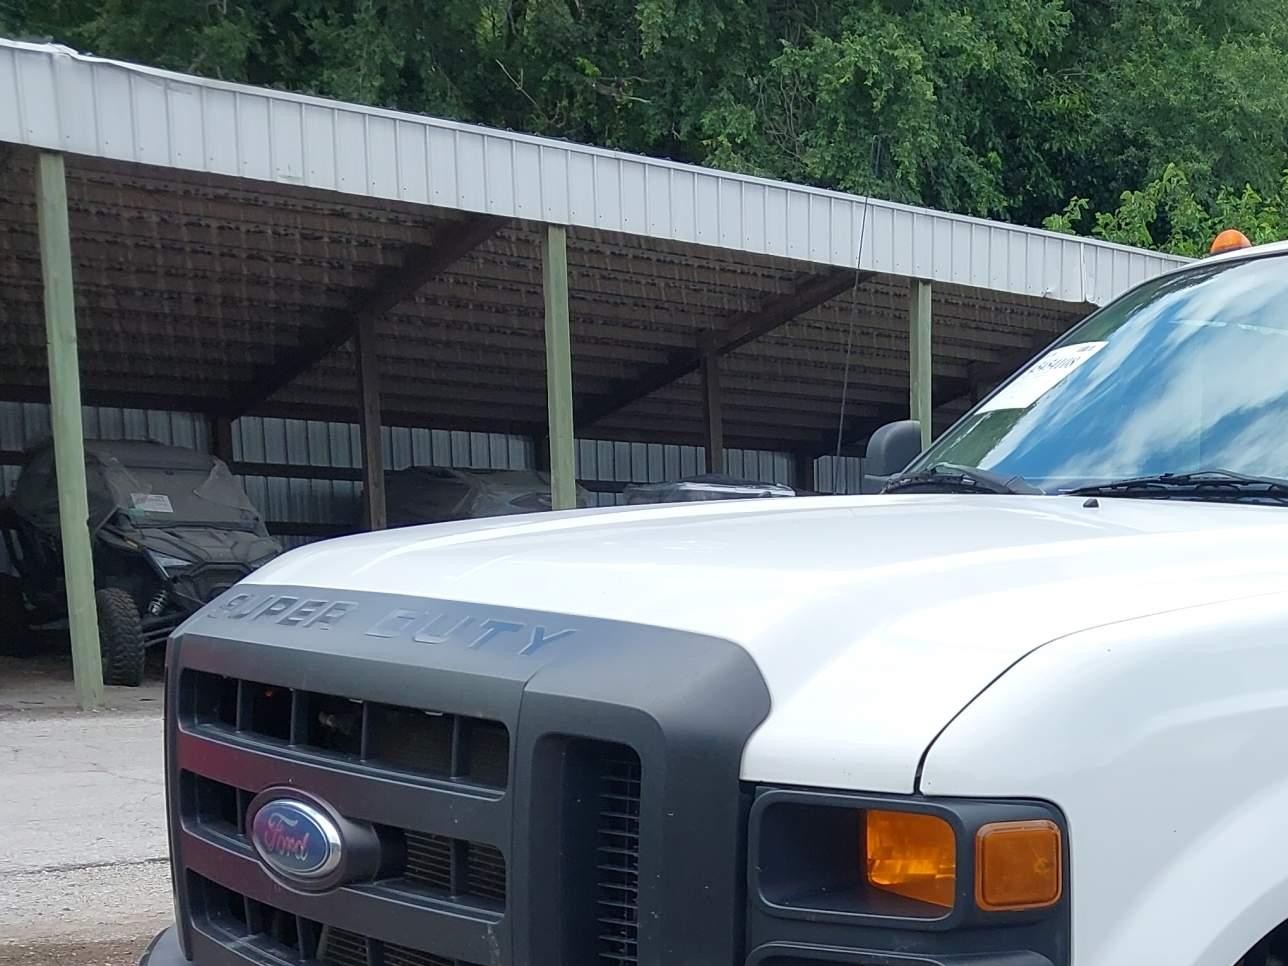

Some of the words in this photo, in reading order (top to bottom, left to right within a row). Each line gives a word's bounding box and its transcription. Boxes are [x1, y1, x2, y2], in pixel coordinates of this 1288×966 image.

[206, 592, 359, 631] SUPER
[363, 608, 578, 655] DUTY
[264, 812, 310, 861] Ford
